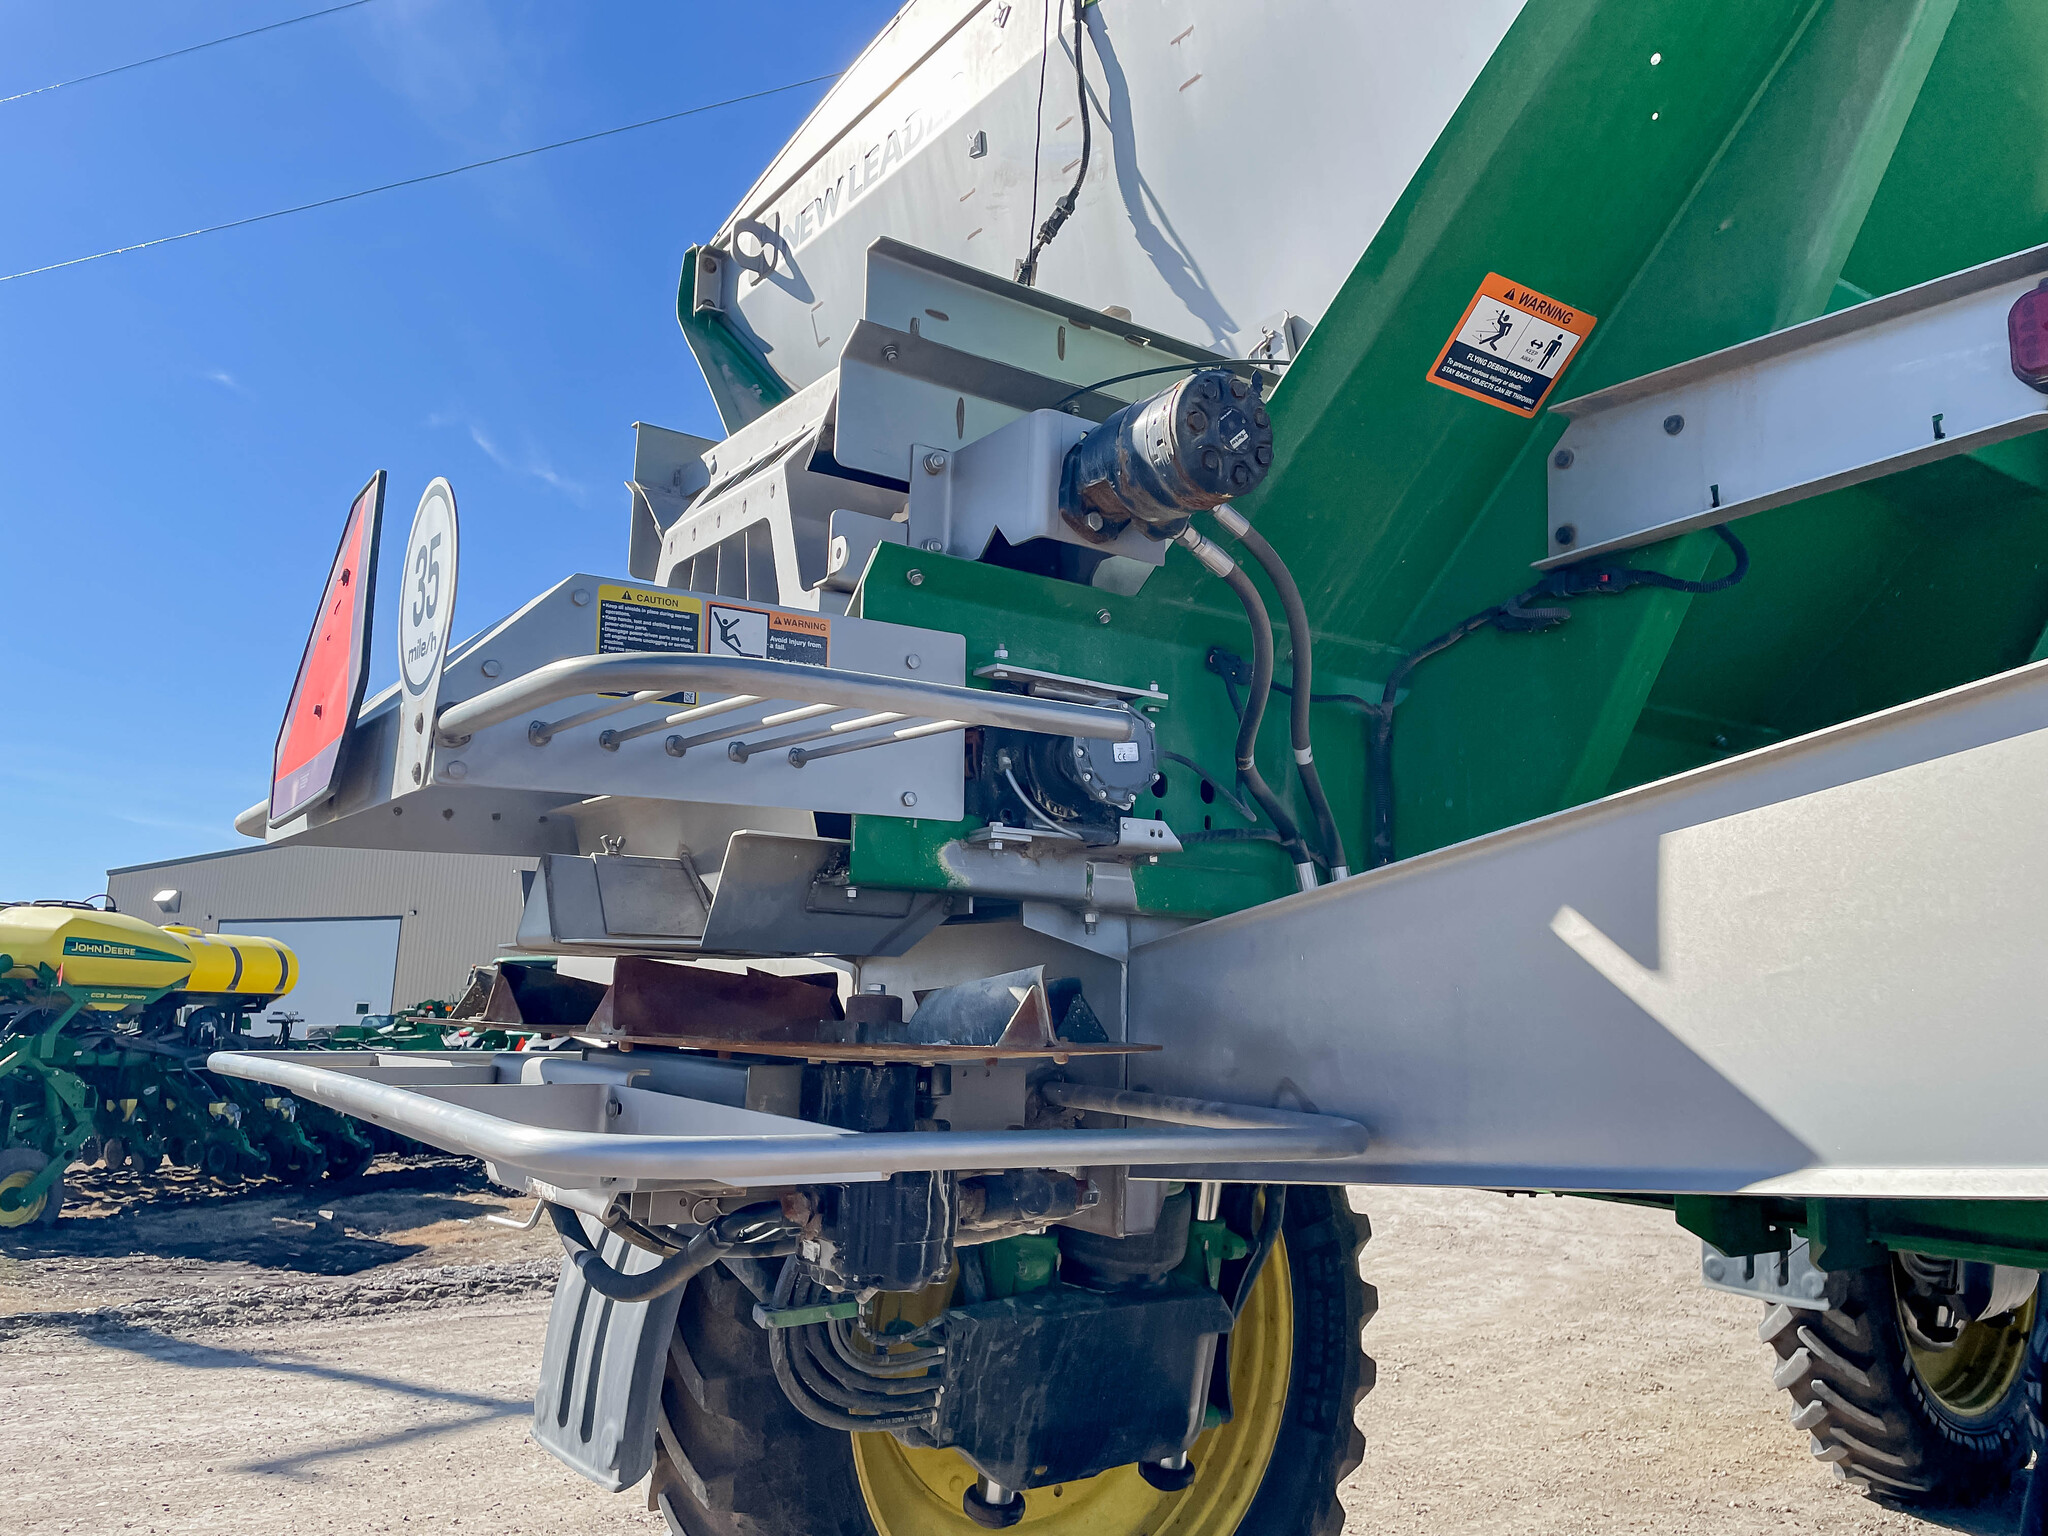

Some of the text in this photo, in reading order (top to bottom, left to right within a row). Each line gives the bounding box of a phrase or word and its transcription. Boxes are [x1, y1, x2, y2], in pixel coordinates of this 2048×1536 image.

[783, 98, 956, 249] NEW LEAD
[1518, 291, 1574, 324] WARNING
[1520, 354, 1534, 363] AWAY
[1525, 348, 1539, 356] KEEP
[1447, 357, 1453, 365] To
[1453, 361, 1473, 373] prevent
[1471, 367, 1490, 379] serious
[1488, 373, 1503, 385] injury
[1466, 352, 1534, 384] FLYING DEBRIS HAZARD!
[1441, 365, 1535, 406] STAY BACK! OBJECTS CAN BE THROWN!
[412, 531, 442, 628] 35
[636, 594, 679, 608] CAUTION
[783, 617, 827, 631] WARNING
[407, 631, 437, 665] mile/h
[769, 636, 788, 644] Avoid
[807, 641, 822, 649] from
[774, 643, 787, 651] fall.
[71, 941, 136, 956] JOHN DEERE
[122, 993, 147, 1001] Delivery
